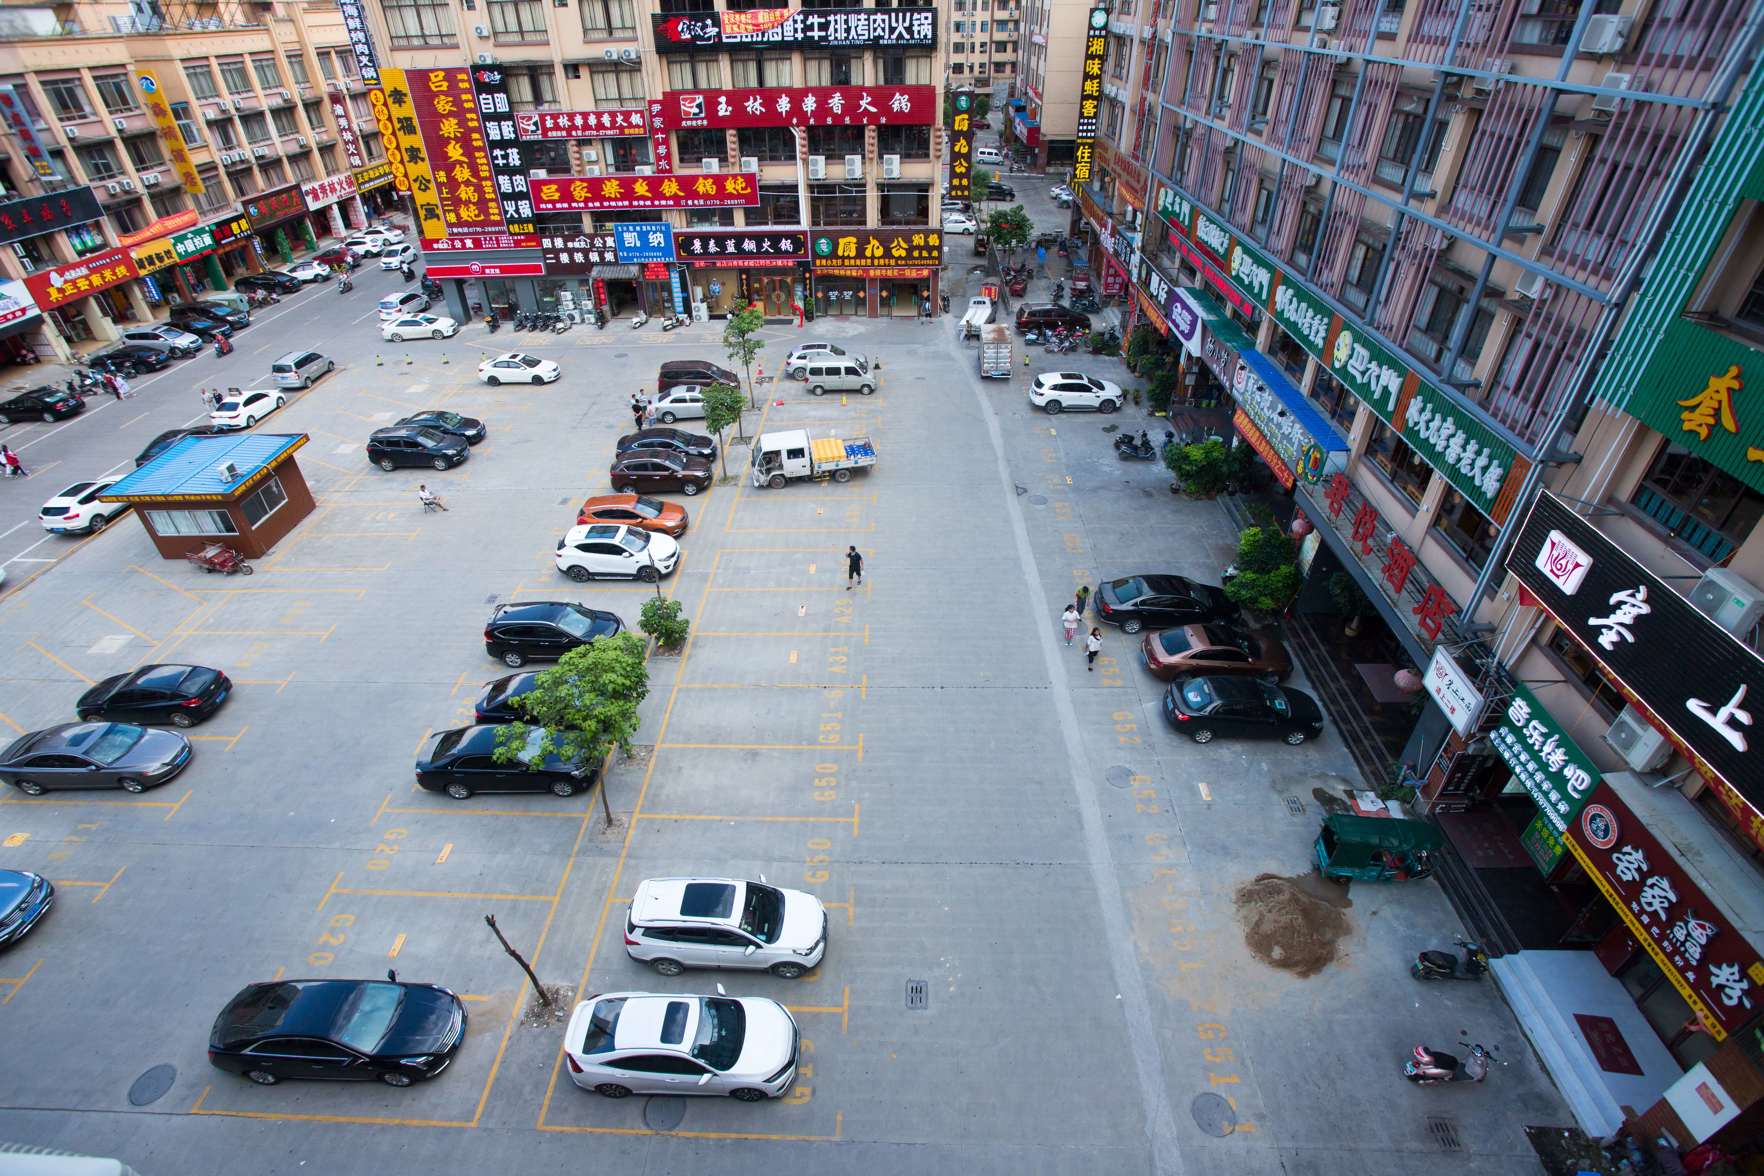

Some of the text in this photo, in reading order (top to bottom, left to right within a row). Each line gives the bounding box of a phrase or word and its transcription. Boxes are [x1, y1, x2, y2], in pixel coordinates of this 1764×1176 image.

[1082, 37, 1105, 117] 湘味蚝客
[479, 93, 509, 113] 自助
[717, 92, 911, 118] 玉林串串香火锅
[486, 120, 516, 140] 海鲜
[545, 112, 643, 129] 玉林串串香火锅
[493, 148, 521, 167] 牛排
[1075, 145, 1092, 179] 住宿
[504, 200, 532, 218] 火锅
[623, 232, 664, 247] 凯纳
[690, 238, 794, 254] 景泰蓝铜火锅
[1507, 696, 1592, 800] 音乐烤吧
